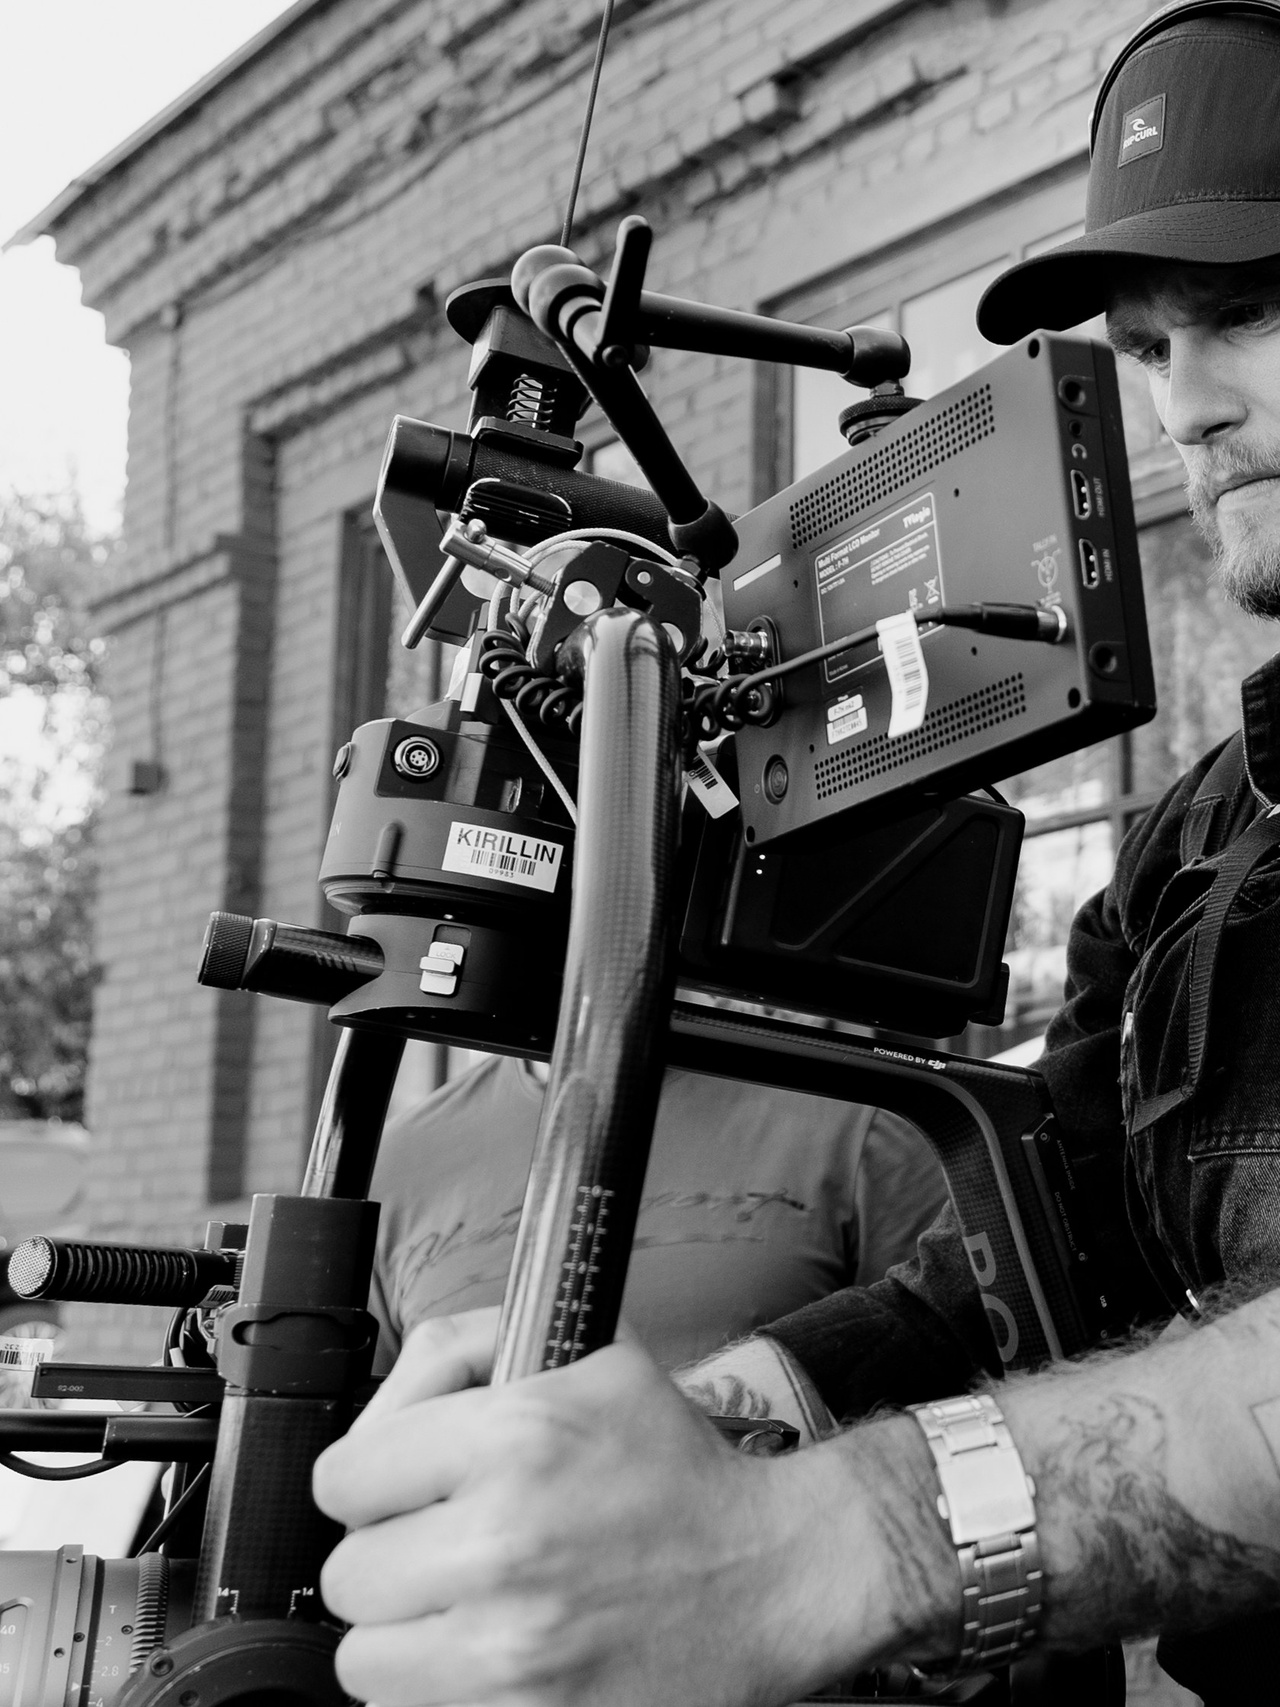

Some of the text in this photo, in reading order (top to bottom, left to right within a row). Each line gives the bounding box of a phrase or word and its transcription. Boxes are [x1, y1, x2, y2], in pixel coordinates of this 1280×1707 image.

[457, 827, 556, 864] KIRILLIN
[873, 1047, 914, 1062] POWERED
[915, 1056, 926, 1064] BY
[1100, 1295, 1108, 1308] USB
[217, 1586, 229, 1597] 14
[302, 1586, 314, 1597] 14
[109, 1604, 117, 1615] T
[0, 1624, 16, 1635] 40
[105, 1635, 113, 1647] 2
[101, 1665, 119, 1677] 2.8
